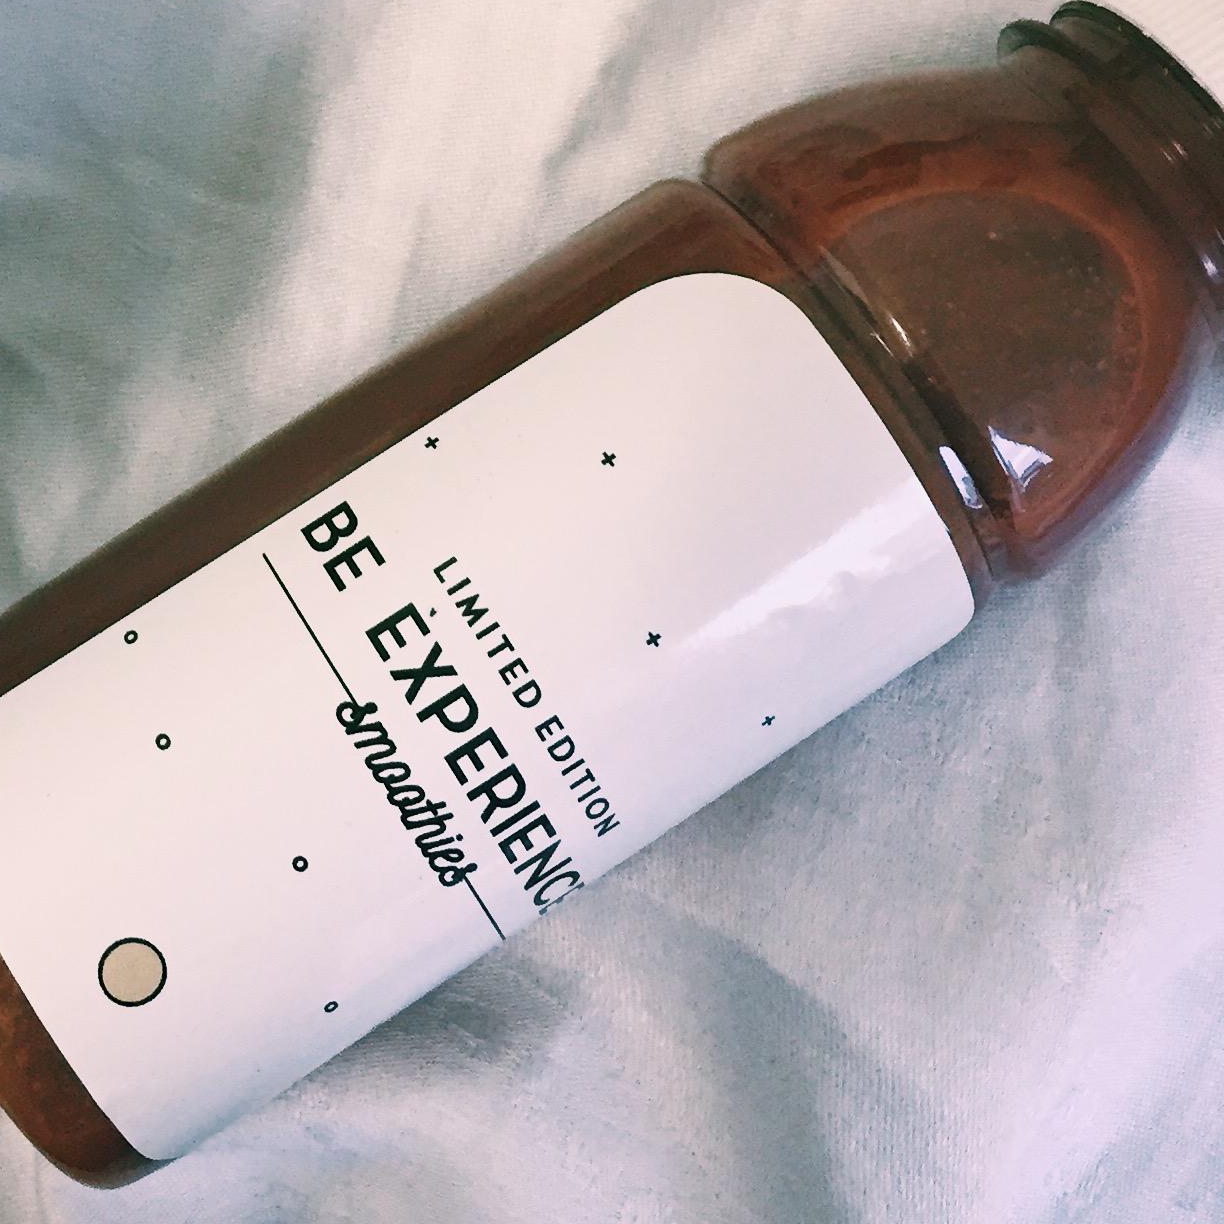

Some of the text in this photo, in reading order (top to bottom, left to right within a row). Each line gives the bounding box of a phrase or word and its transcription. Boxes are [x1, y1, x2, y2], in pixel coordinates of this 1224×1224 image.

[300, 500, 387, 593] BE
[433, 556, 621, 838] LIMITED EDITION
[335, 700, 478, 888] smoothies
